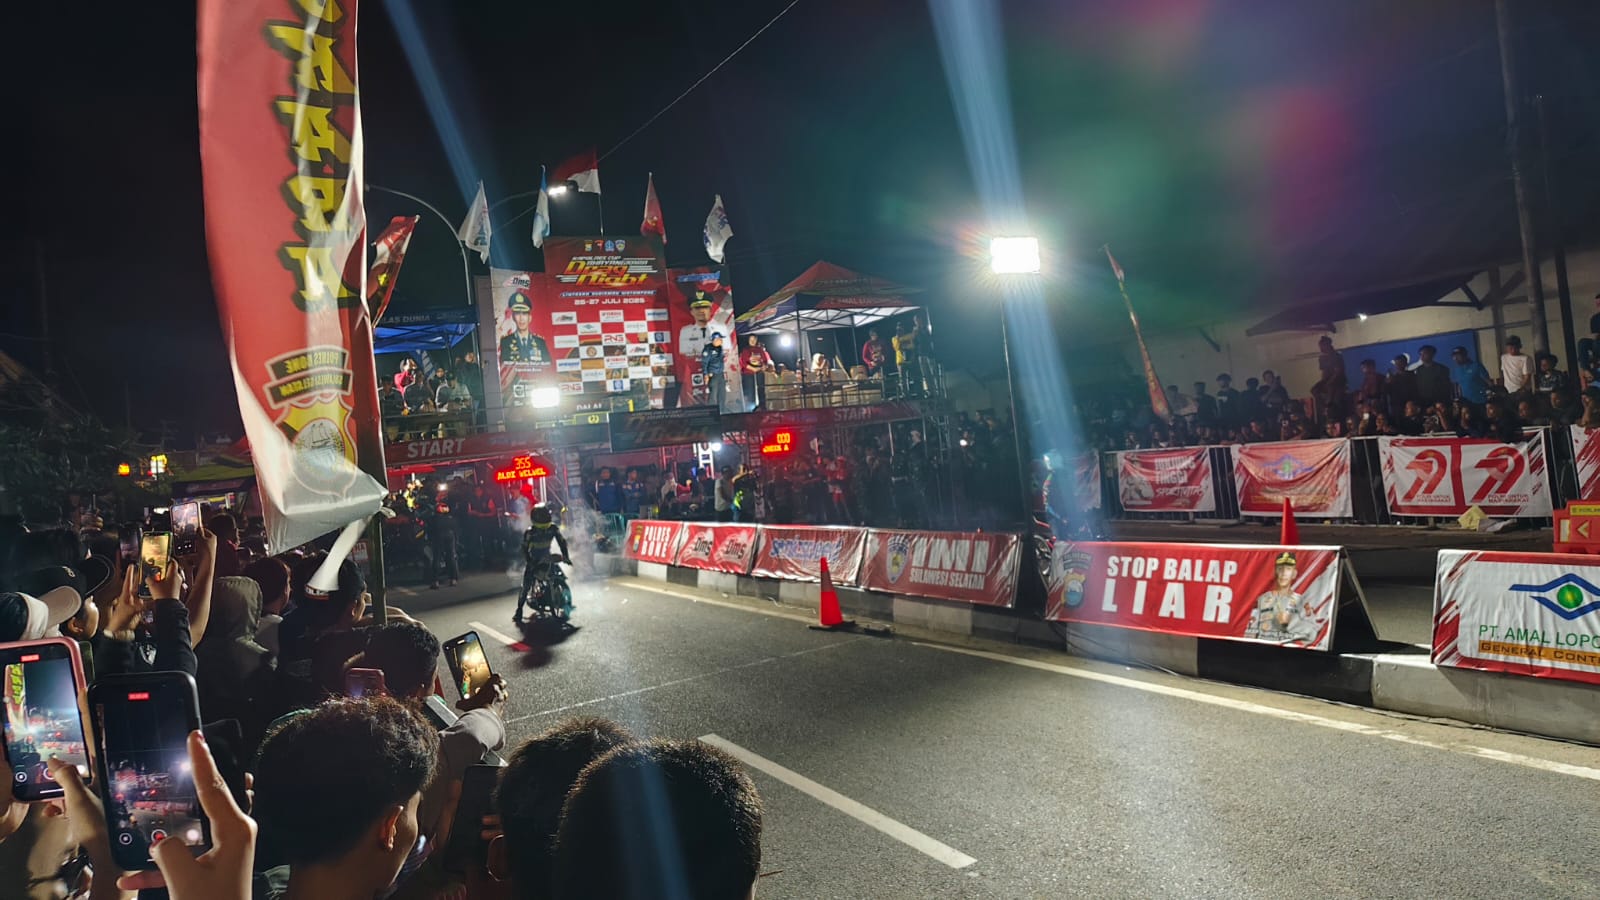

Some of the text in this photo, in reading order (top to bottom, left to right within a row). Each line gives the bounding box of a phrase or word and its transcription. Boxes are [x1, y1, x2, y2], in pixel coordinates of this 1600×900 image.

[834, 408, 873, 421] START
[407, 437, 465, 458] START
[514, 456, 532, 470] 355
[643, 526, 671, 543] POLRES
[641, 541, 667, 558] BONE
[911, 537, 988, 574] IMI
[909, 567, 986, 591] SULAWESI SELATAN
[1106, 556, 1160, 579] STOP
[1163, 558, 1238, 583] BALAP
[1479, 624, 1500, 639] PT.
[1504, 627, 1551, 644] AMAL
[1480, 642, 1600, 664] GENERAL CONT
